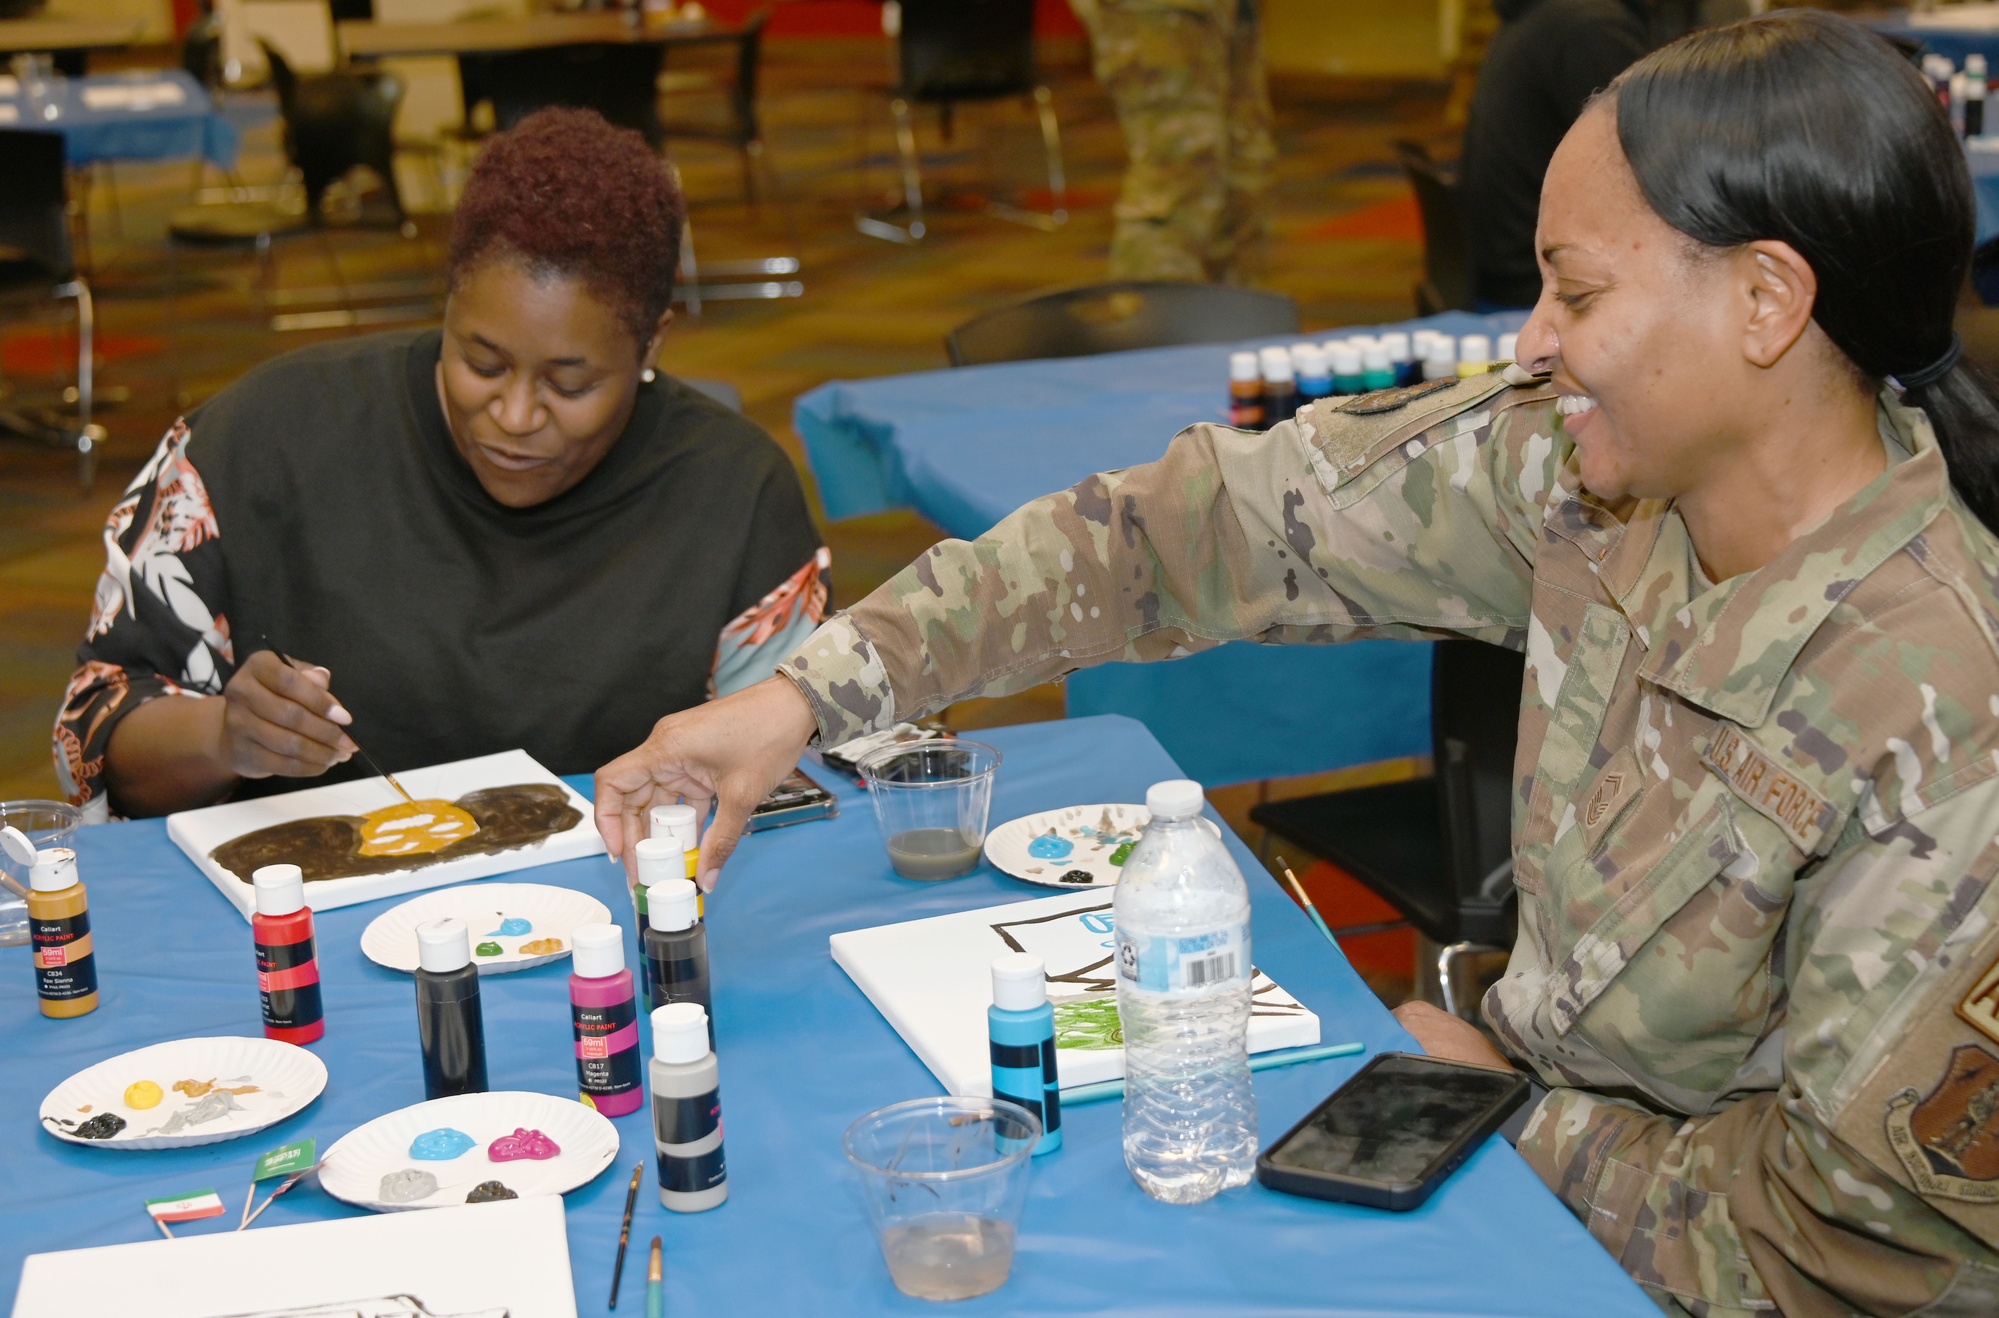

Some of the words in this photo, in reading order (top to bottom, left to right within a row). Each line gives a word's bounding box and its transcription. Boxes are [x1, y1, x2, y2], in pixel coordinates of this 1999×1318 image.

[1731, 750, 1767, 797] AIR
[1762, 772, 1825, 839] FORCE
[55, 933, 74, 941] PAINT
[43, 948, 62, 956] 59ml
[574, 1022, 595, 1030] ACRYLIC
[583, 1038, 603, 1046] 59ml
[585, 1070, 609, 1078] Magenta
